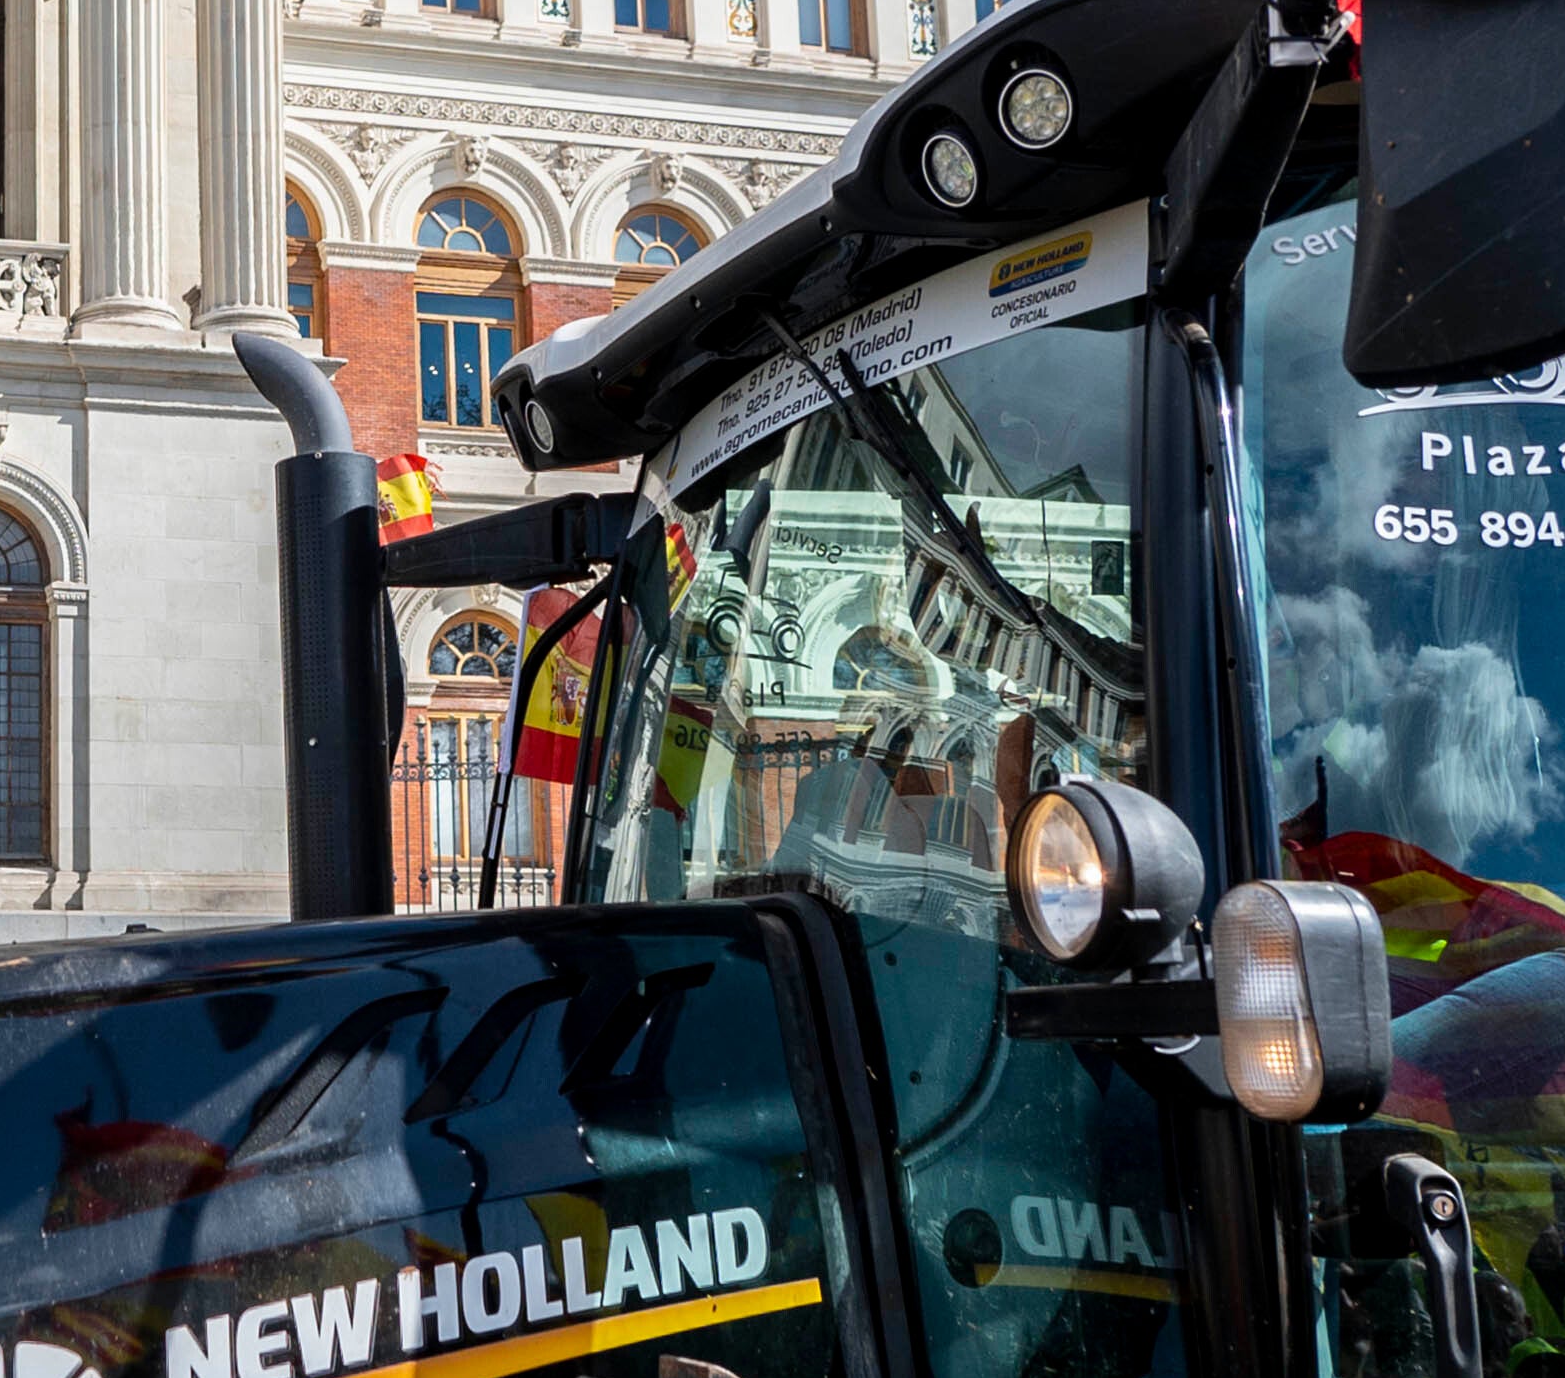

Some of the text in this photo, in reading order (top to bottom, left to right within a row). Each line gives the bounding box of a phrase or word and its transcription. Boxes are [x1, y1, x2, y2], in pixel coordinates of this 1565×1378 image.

[991, 280, 1077, 319] CONCESIONARIO
[1010, 307, 1049, 329] OFICIAL
[748, 368, 766, 393] 91
[824, 323, 846, 349] 08
[850, 287, 923, 339] (Madrid)
[745, 389, 772, 419] 925
[774, 376, 794, 401] 27
[1374, 505, 1458, 546] 655
[1480, 510, 1565, 548] 894
[398, 1206, 769, 1353] HOLLAND
